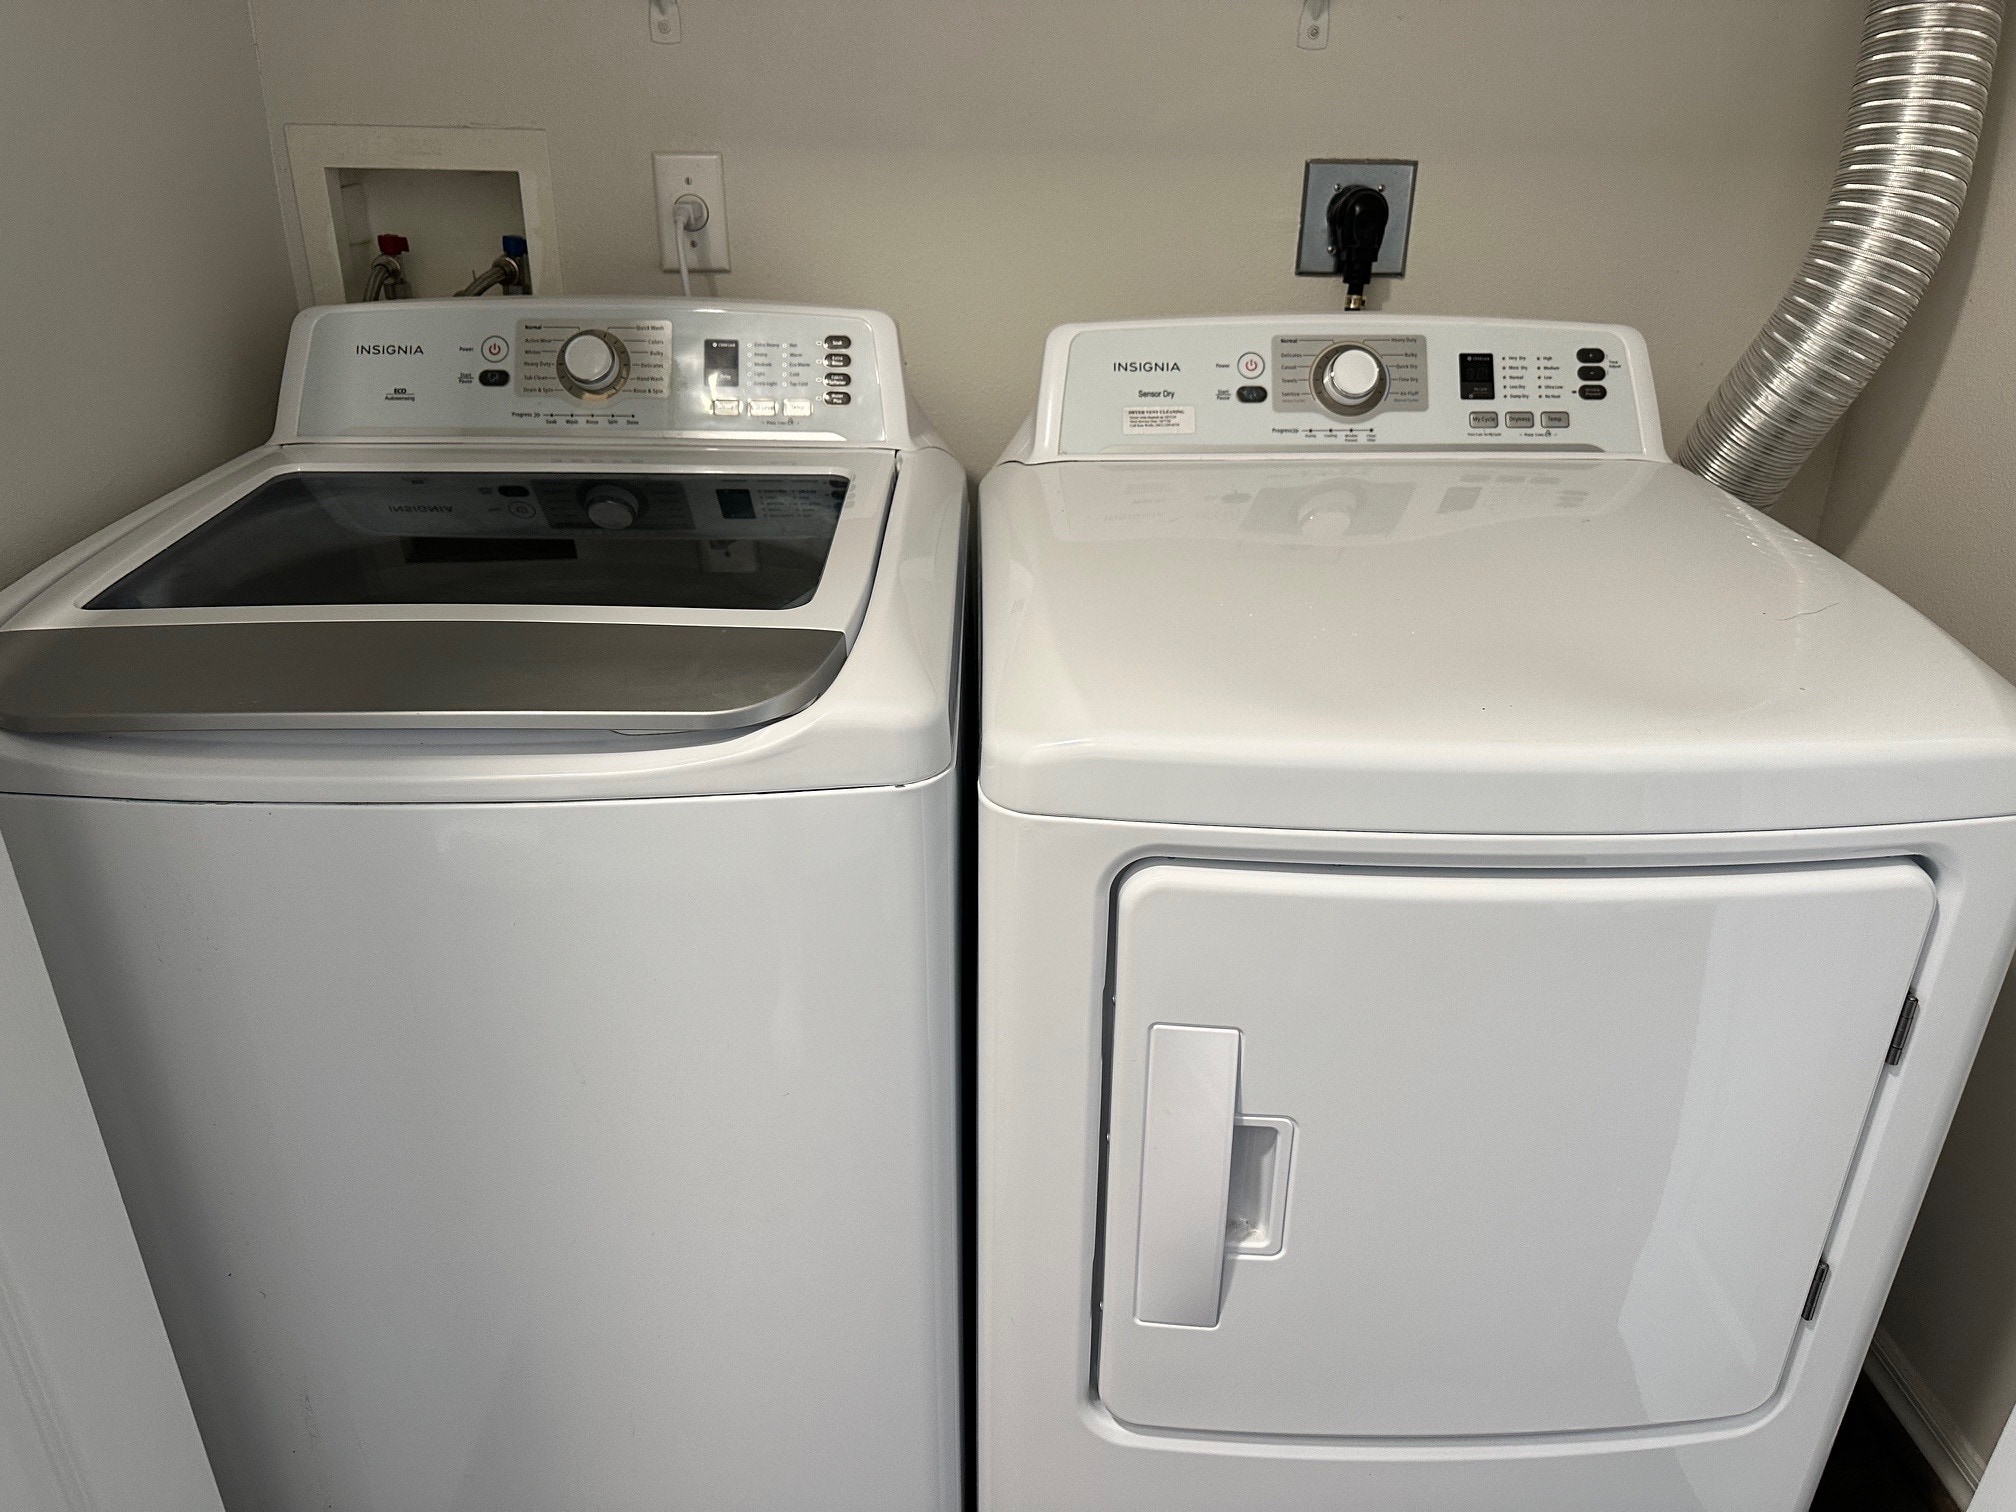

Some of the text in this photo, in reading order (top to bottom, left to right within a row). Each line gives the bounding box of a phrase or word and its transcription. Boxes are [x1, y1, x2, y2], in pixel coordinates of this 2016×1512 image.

[356, 345, 424, 355] INSIGNIA
[1113, 361, 1181, 373] INSIGNIA
[1138, 389, 1175, 399] Sensor Dry
